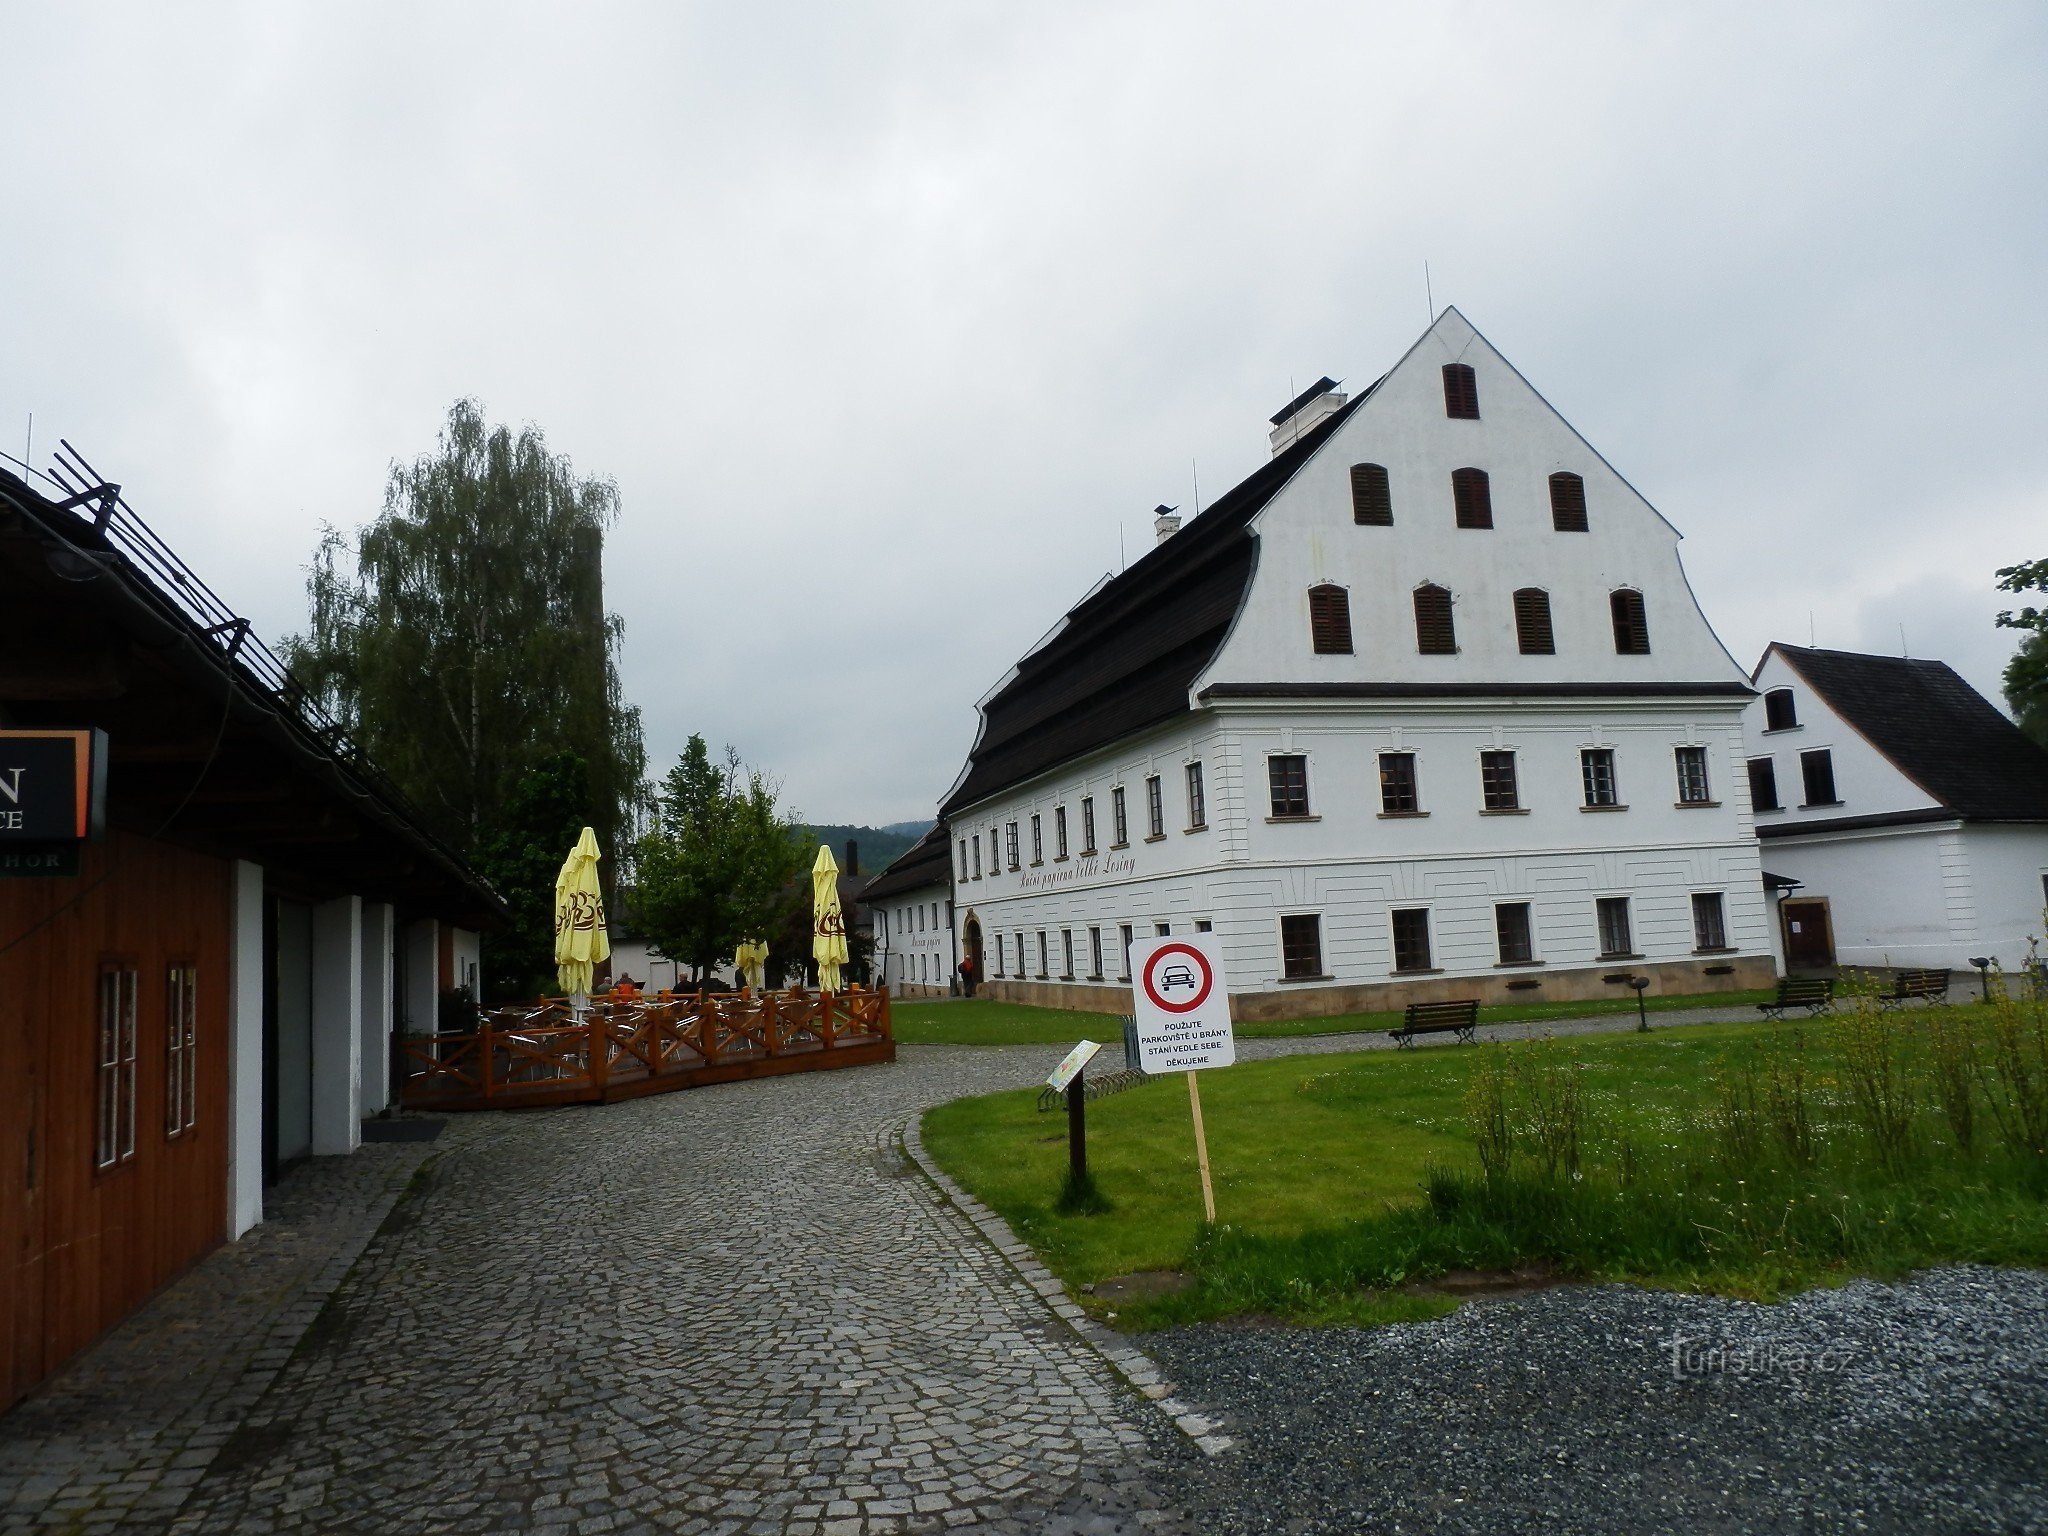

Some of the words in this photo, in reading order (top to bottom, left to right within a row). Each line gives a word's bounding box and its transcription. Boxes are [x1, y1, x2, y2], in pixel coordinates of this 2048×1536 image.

[1102, 851, 1136, 876] Losiny
[1164, 1020, 1202, 1031] POUŽIJTE
[1141, 1031, 1190, 1044] PARKOVIŠTĚ
[1148, 1046, 1172, 1055] STÁNÍ
[1173, 1043, 1199, 1053] VEDLE
[1200, 1041, 1224, 1050] SEBE.
[1166, 1055, 1209, 1067] DĚKUJEME
